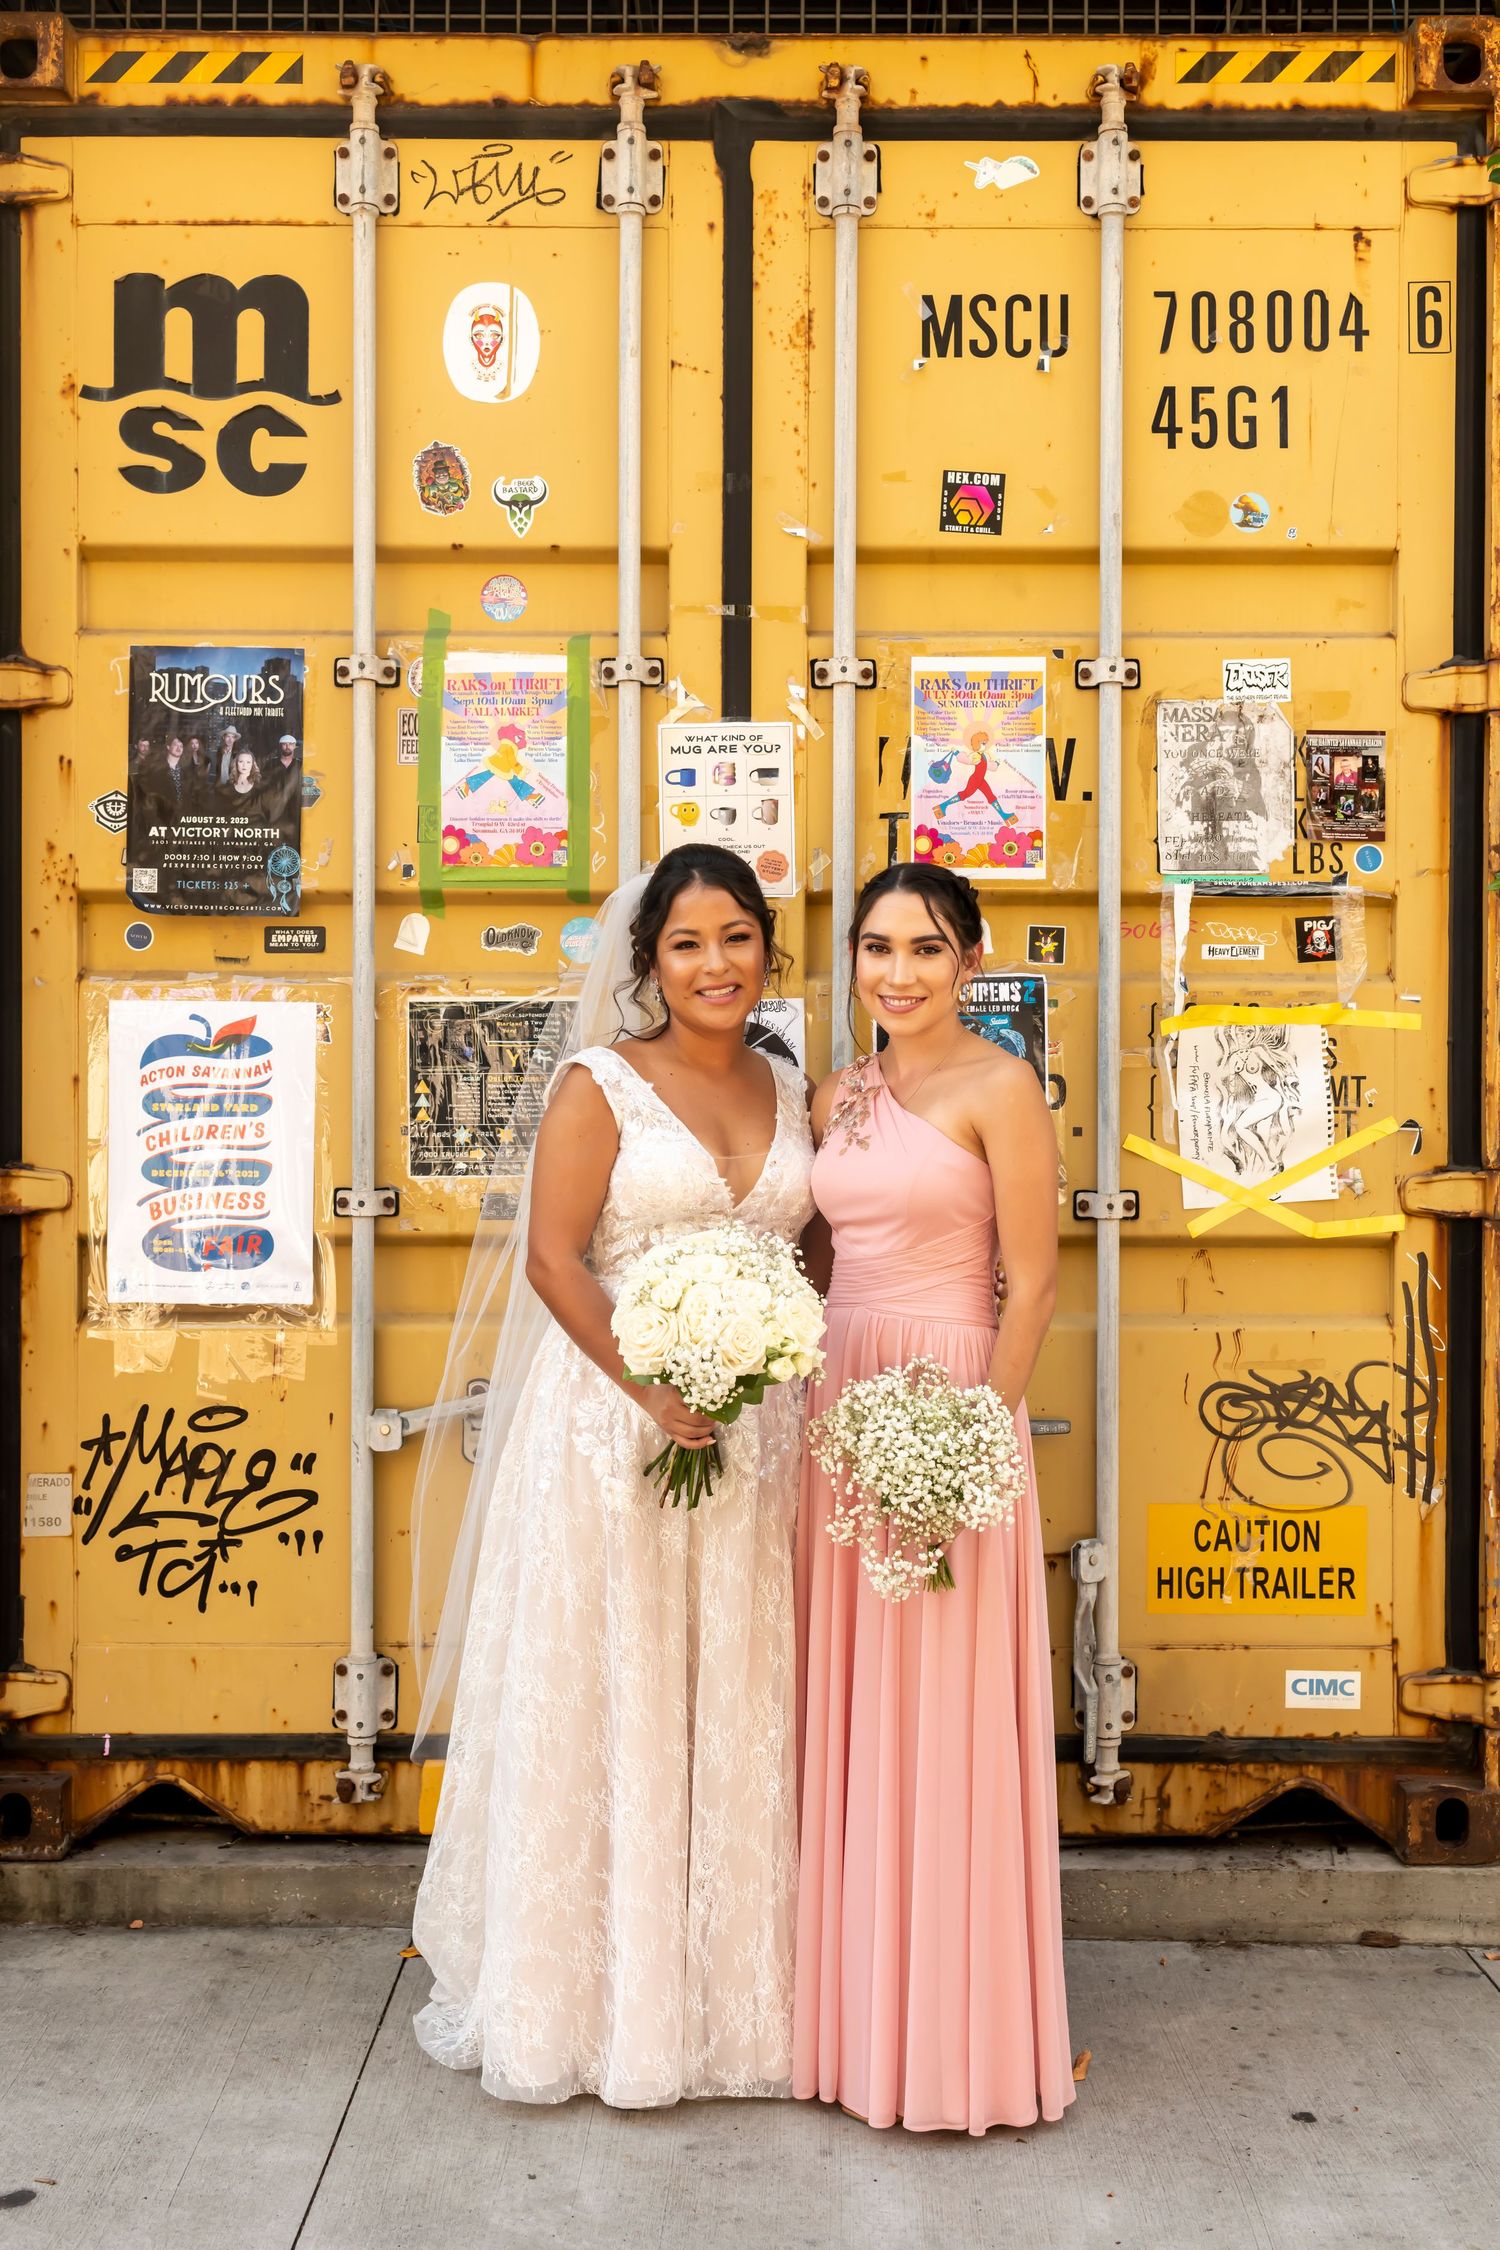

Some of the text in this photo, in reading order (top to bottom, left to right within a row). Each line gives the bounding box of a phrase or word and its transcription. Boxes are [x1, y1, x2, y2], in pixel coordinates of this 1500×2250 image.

[1154, 285, 1442, 353] 708004 6
[921, 294, 1069, 359] MSCU
[1151, 386, 1289, 450] 45G1
[947, 471, 1001, 486] HEX.COM
[447, 679, 487, 691] RAKS
[509, 678, 564, 691] THRIFT
[920, 678, 1038, 691] RAKS on THRIFT
[149, 671, 285, 713] RUMOURS
[922, 690, 1034, 702] JULY 30th 10am 3pm
[453, 697, 474, 707] Sept
[938, 700, 1020, 709] SUMMER MARKET
[265, 708, 284, 718] TRIBUTE
[464, 707, 542, 717] FALL MARKET
[670, 744, 781, 754] MUG ARE YOU?
[1164, 749, 1187, 758] YOU
[1191, 749, 1224, 758] ONCE
[180, 816, 214, 824] AUGUST
[230, 816, 249, 825] 2023
[149, 826, 280, 839] AT VICTORY NORTH
[164, 853, 190, 861] DOORS
[192, 854, 210, 862] 7:30
[218, 854, 240, 862] SHOW
[1292, 842, 1343, 874] LBS
[177, 880, 221, 890] TICKETS:
[224, 880, 239, 889] $25
[1304, 919, 1336, 931] PIGS
[271, 934, 318, 943] EMPATHY
[959, 980, 1037, 1003] SIRENS 2
[958, 1004, 1020, 1012] EMALE LED ROCK
[140, 1059, 273, 1087] ACTON SAVANNAH
[152, 1103, 259, 1113] STARLAND YARD
[146, 1121, 266, 1152] CHILDREN'S
[235, 1170, 260, 1178] 2023
[149, 1191, 267, 1221] BUSINESS
[202, 1235, 263, 1257] FAIR
[1193, 1519, 1321, 1553] CAUTION
[1156, 1567, 1356, 1600] HIGH TRAILER
[1291, 1678, 1355, 1697] CIMC
